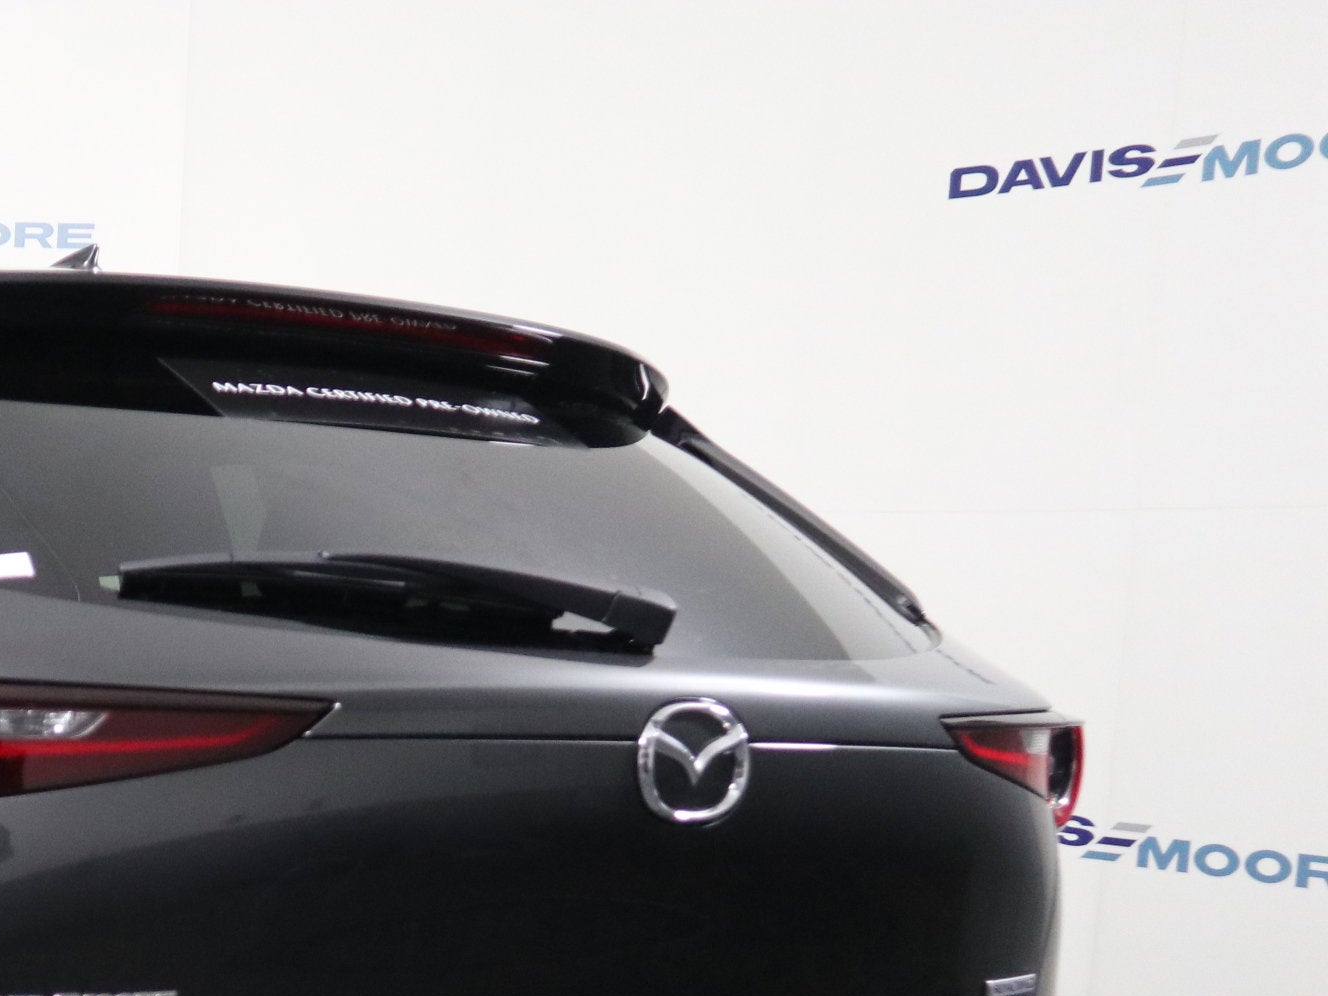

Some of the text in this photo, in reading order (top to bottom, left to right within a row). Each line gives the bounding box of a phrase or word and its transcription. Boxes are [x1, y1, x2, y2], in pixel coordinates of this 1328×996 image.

[948, 133, 1328, 200] DAVIS MO
[211, 380, 306, 397] MAZDA
[306, 386, 414, 407] CERTIFIED
